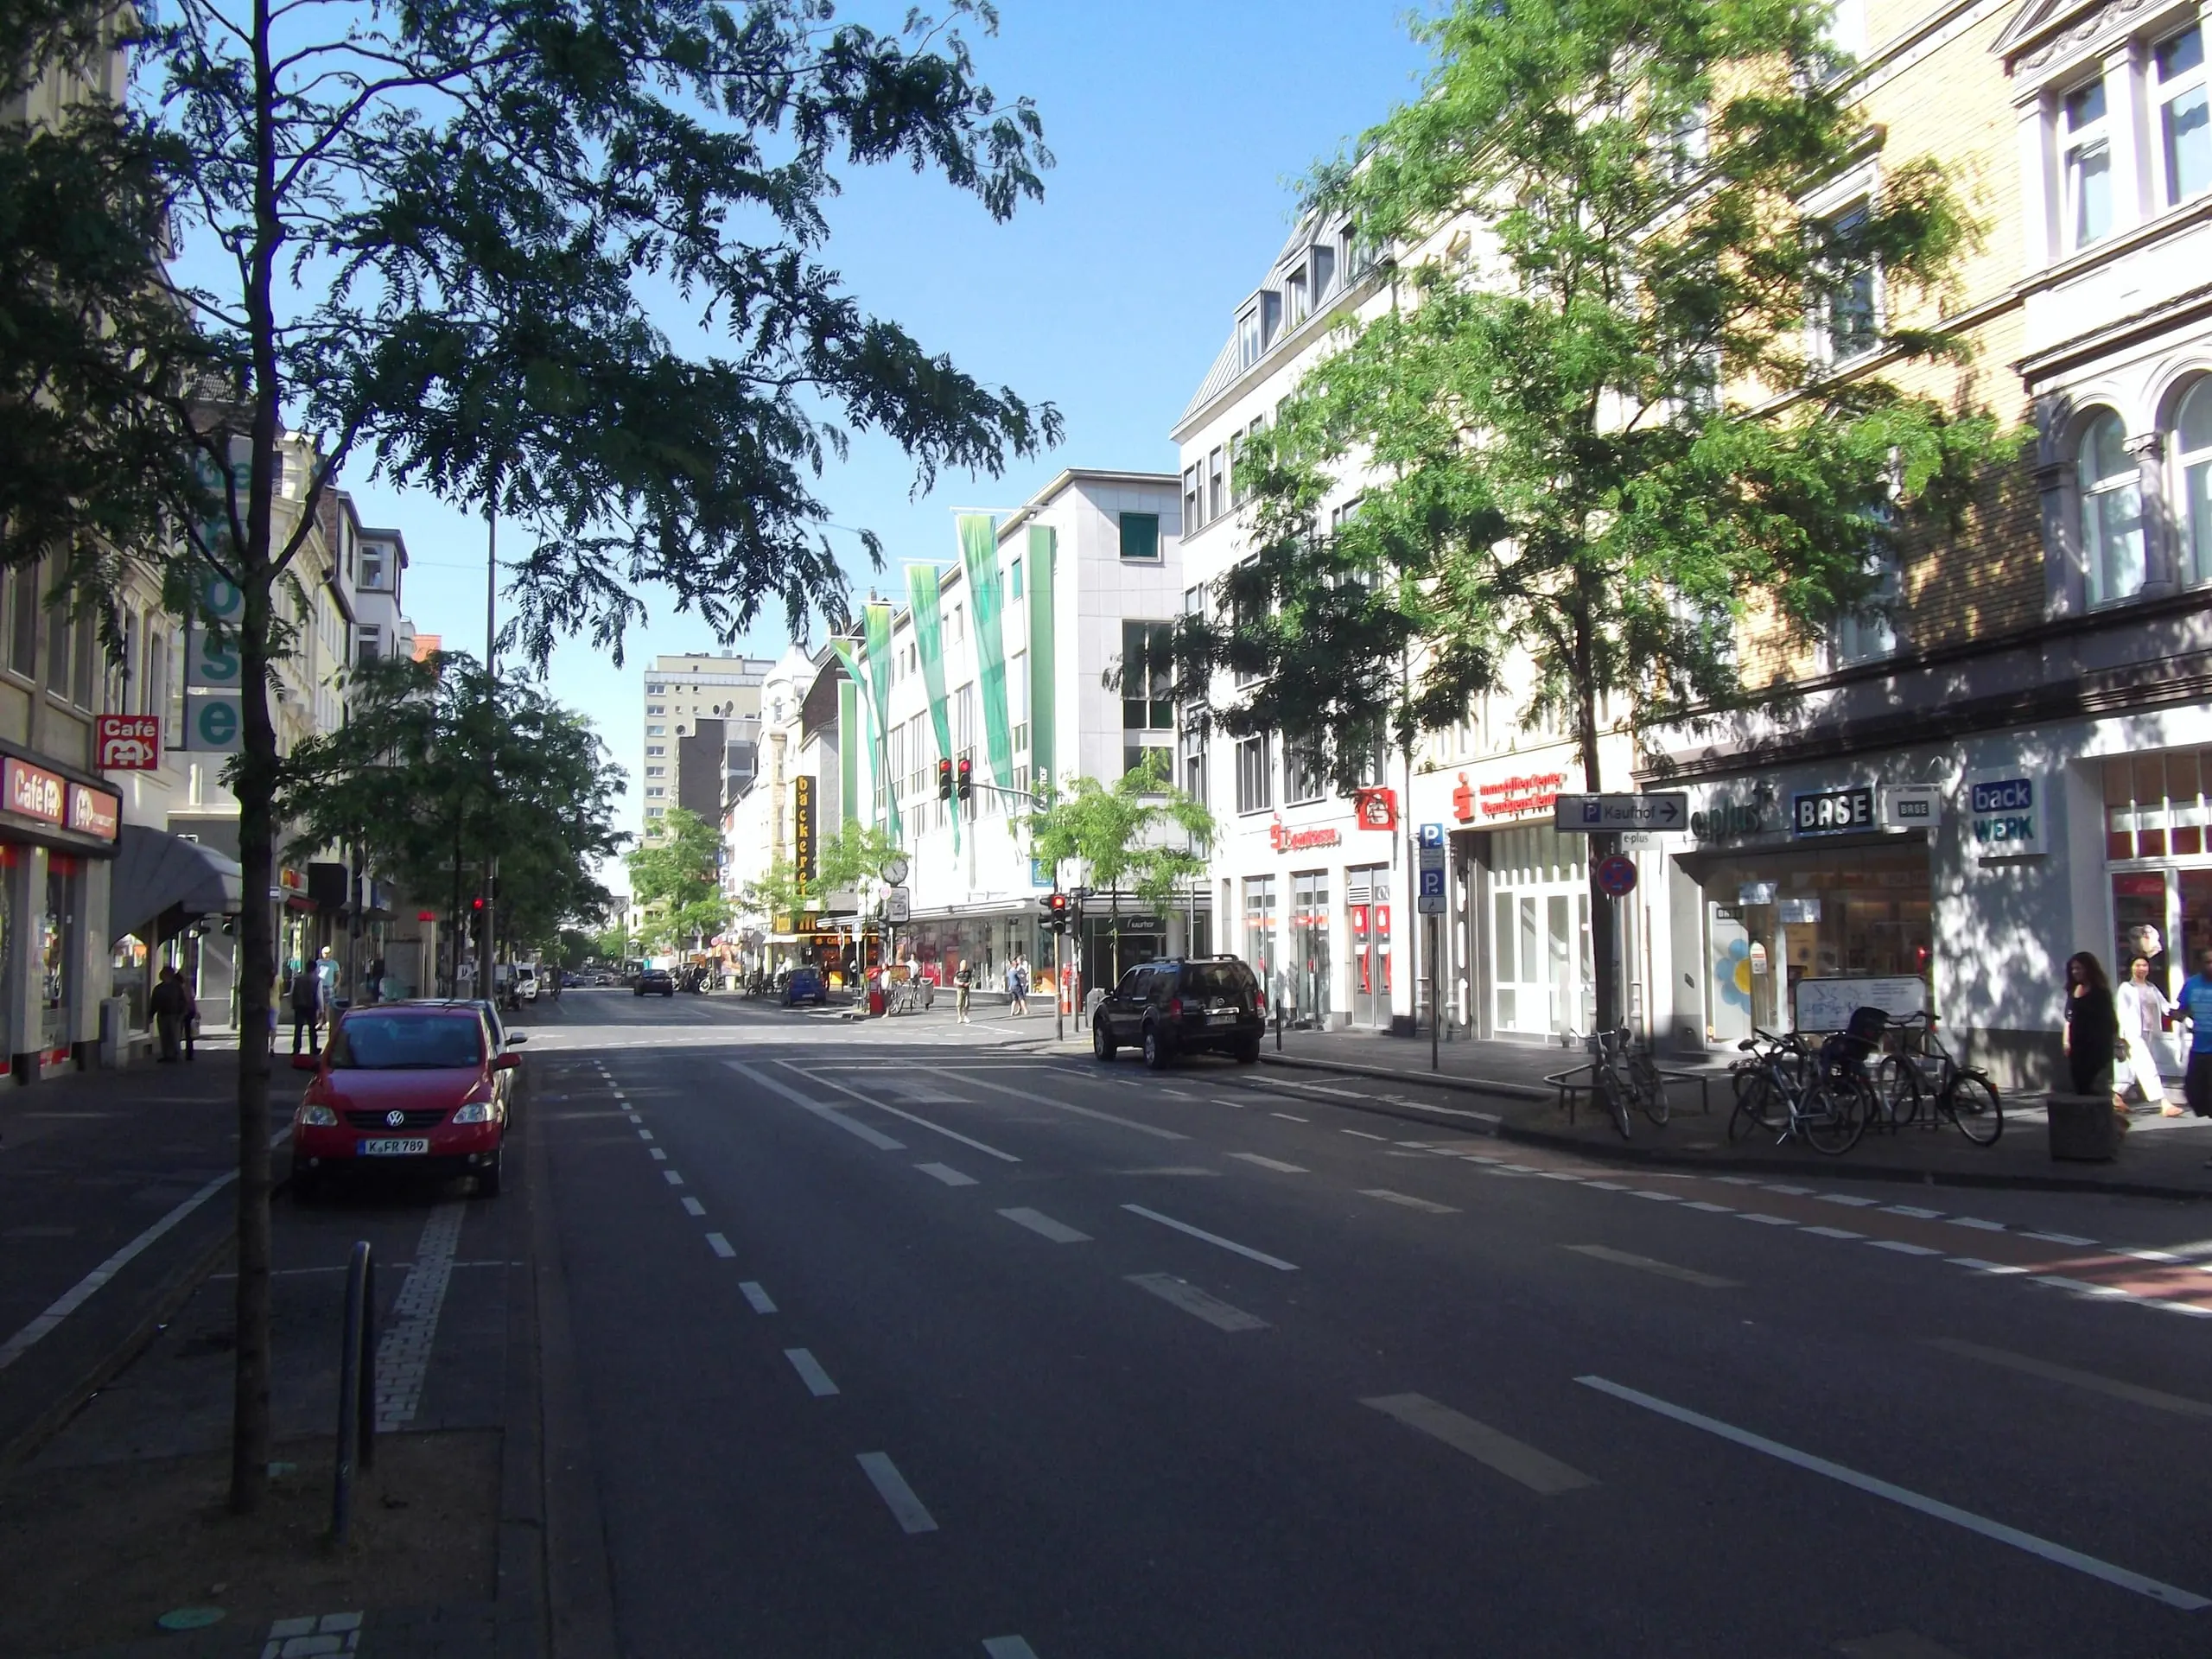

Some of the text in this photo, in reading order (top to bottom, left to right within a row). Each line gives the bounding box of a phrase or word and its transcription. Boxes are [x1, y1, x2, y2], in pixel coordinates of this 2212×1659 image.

[104, 719, 156, 737] Café
[15, 768, 43, 812] Café
[1975, 782, 2030, 810] back
[1605, 804, 1656, 820] Kaufhof
[1800, 795, 1867, 828] BASE
[1900, 804, 1928, 815] BASE
[1425, 825, 1439, 847] P
[1624, 831, 1649, 845] e-plus
[1973, 816, 2034, 843] WERK
[1426, 873, 1439, 893] P
[403, 1141, 423, 1152] 789
